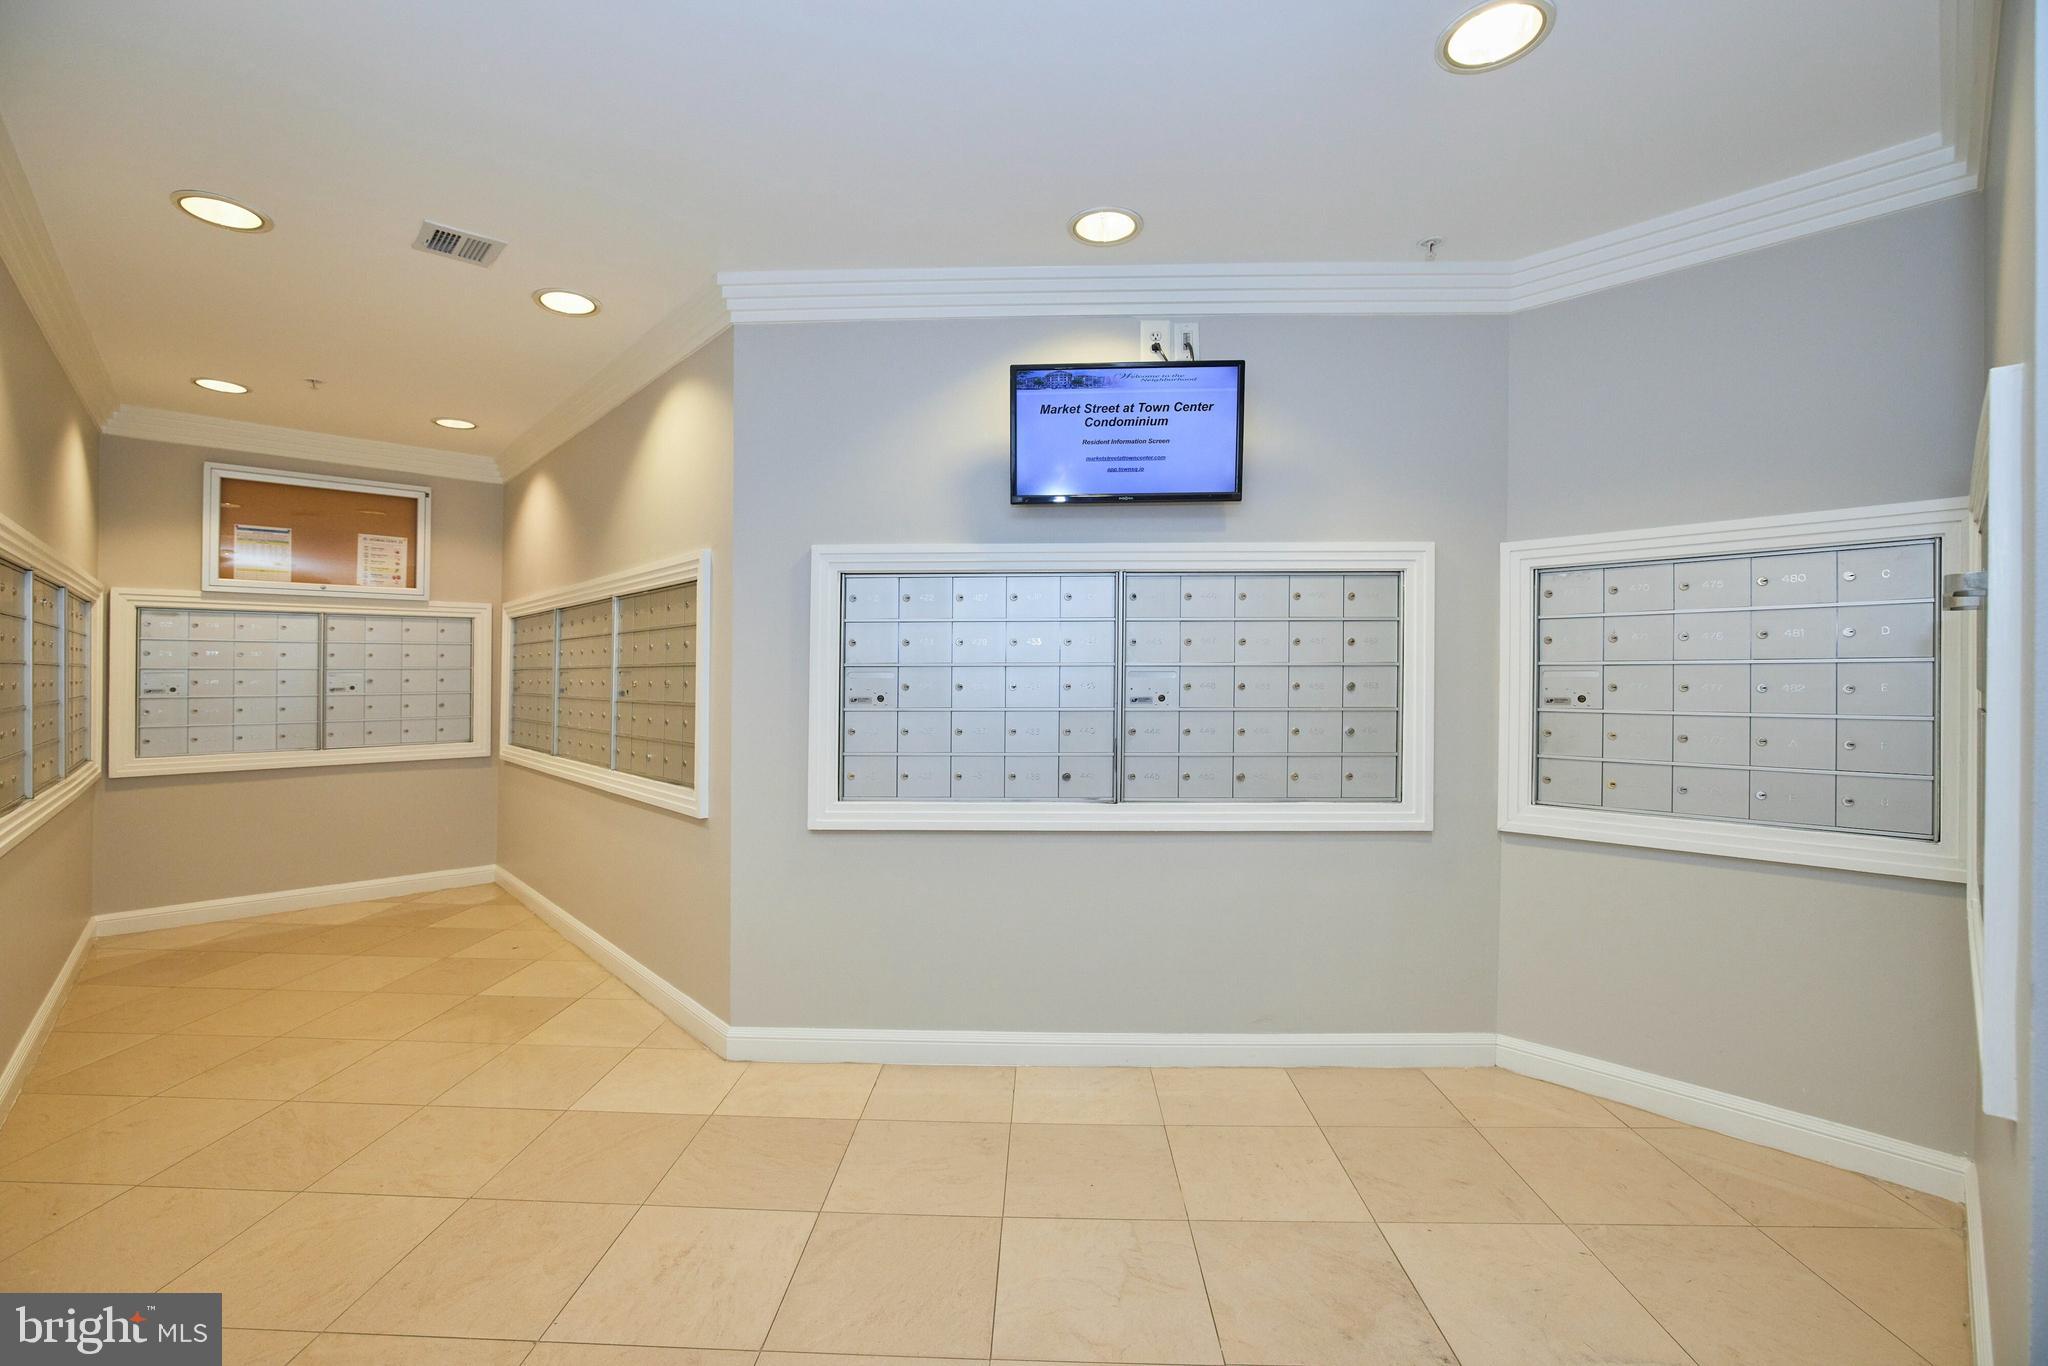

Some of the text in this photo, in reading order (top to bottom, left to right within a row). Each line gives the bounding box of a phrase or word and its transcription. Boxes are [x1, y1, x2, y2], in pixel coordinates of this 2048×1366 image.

[1040, 401, 1214, 415] Market Street at Town Center
[1085, 416, 1169, 428] Condominium
[1781, 573, 1807, 584] 480
[1881, 569, 1891, 579] C
[1784, 628, 1805, 639] 481
[1881, 626, 1891, 636] D
